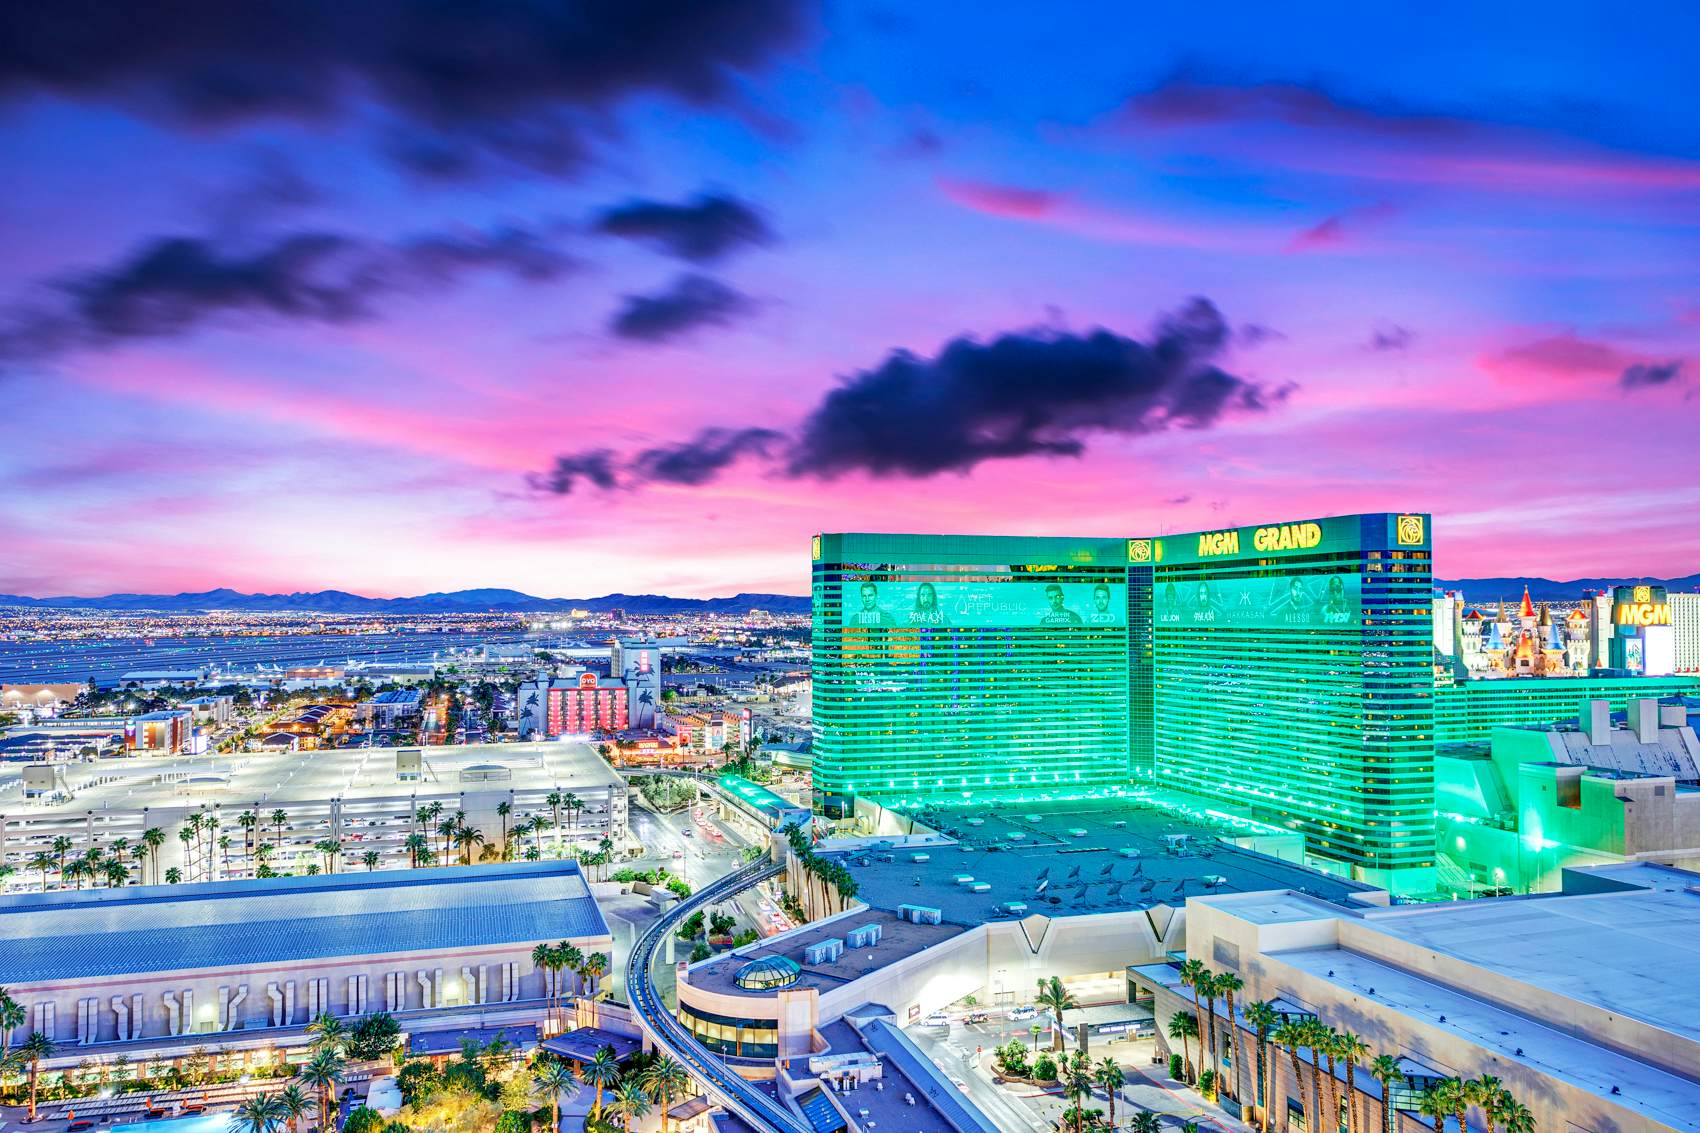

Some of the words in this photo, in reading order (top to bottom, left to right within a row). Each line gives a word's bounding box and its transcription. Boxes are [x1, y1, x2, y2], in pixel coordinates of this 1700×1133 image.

[1198, 532, 1239, 556] MGM
[1253, 523, 1321, 551] GRAND
[968, 602, 1027, 611] REPUBLIC
[1619, 603, 1672, 626] MGM
